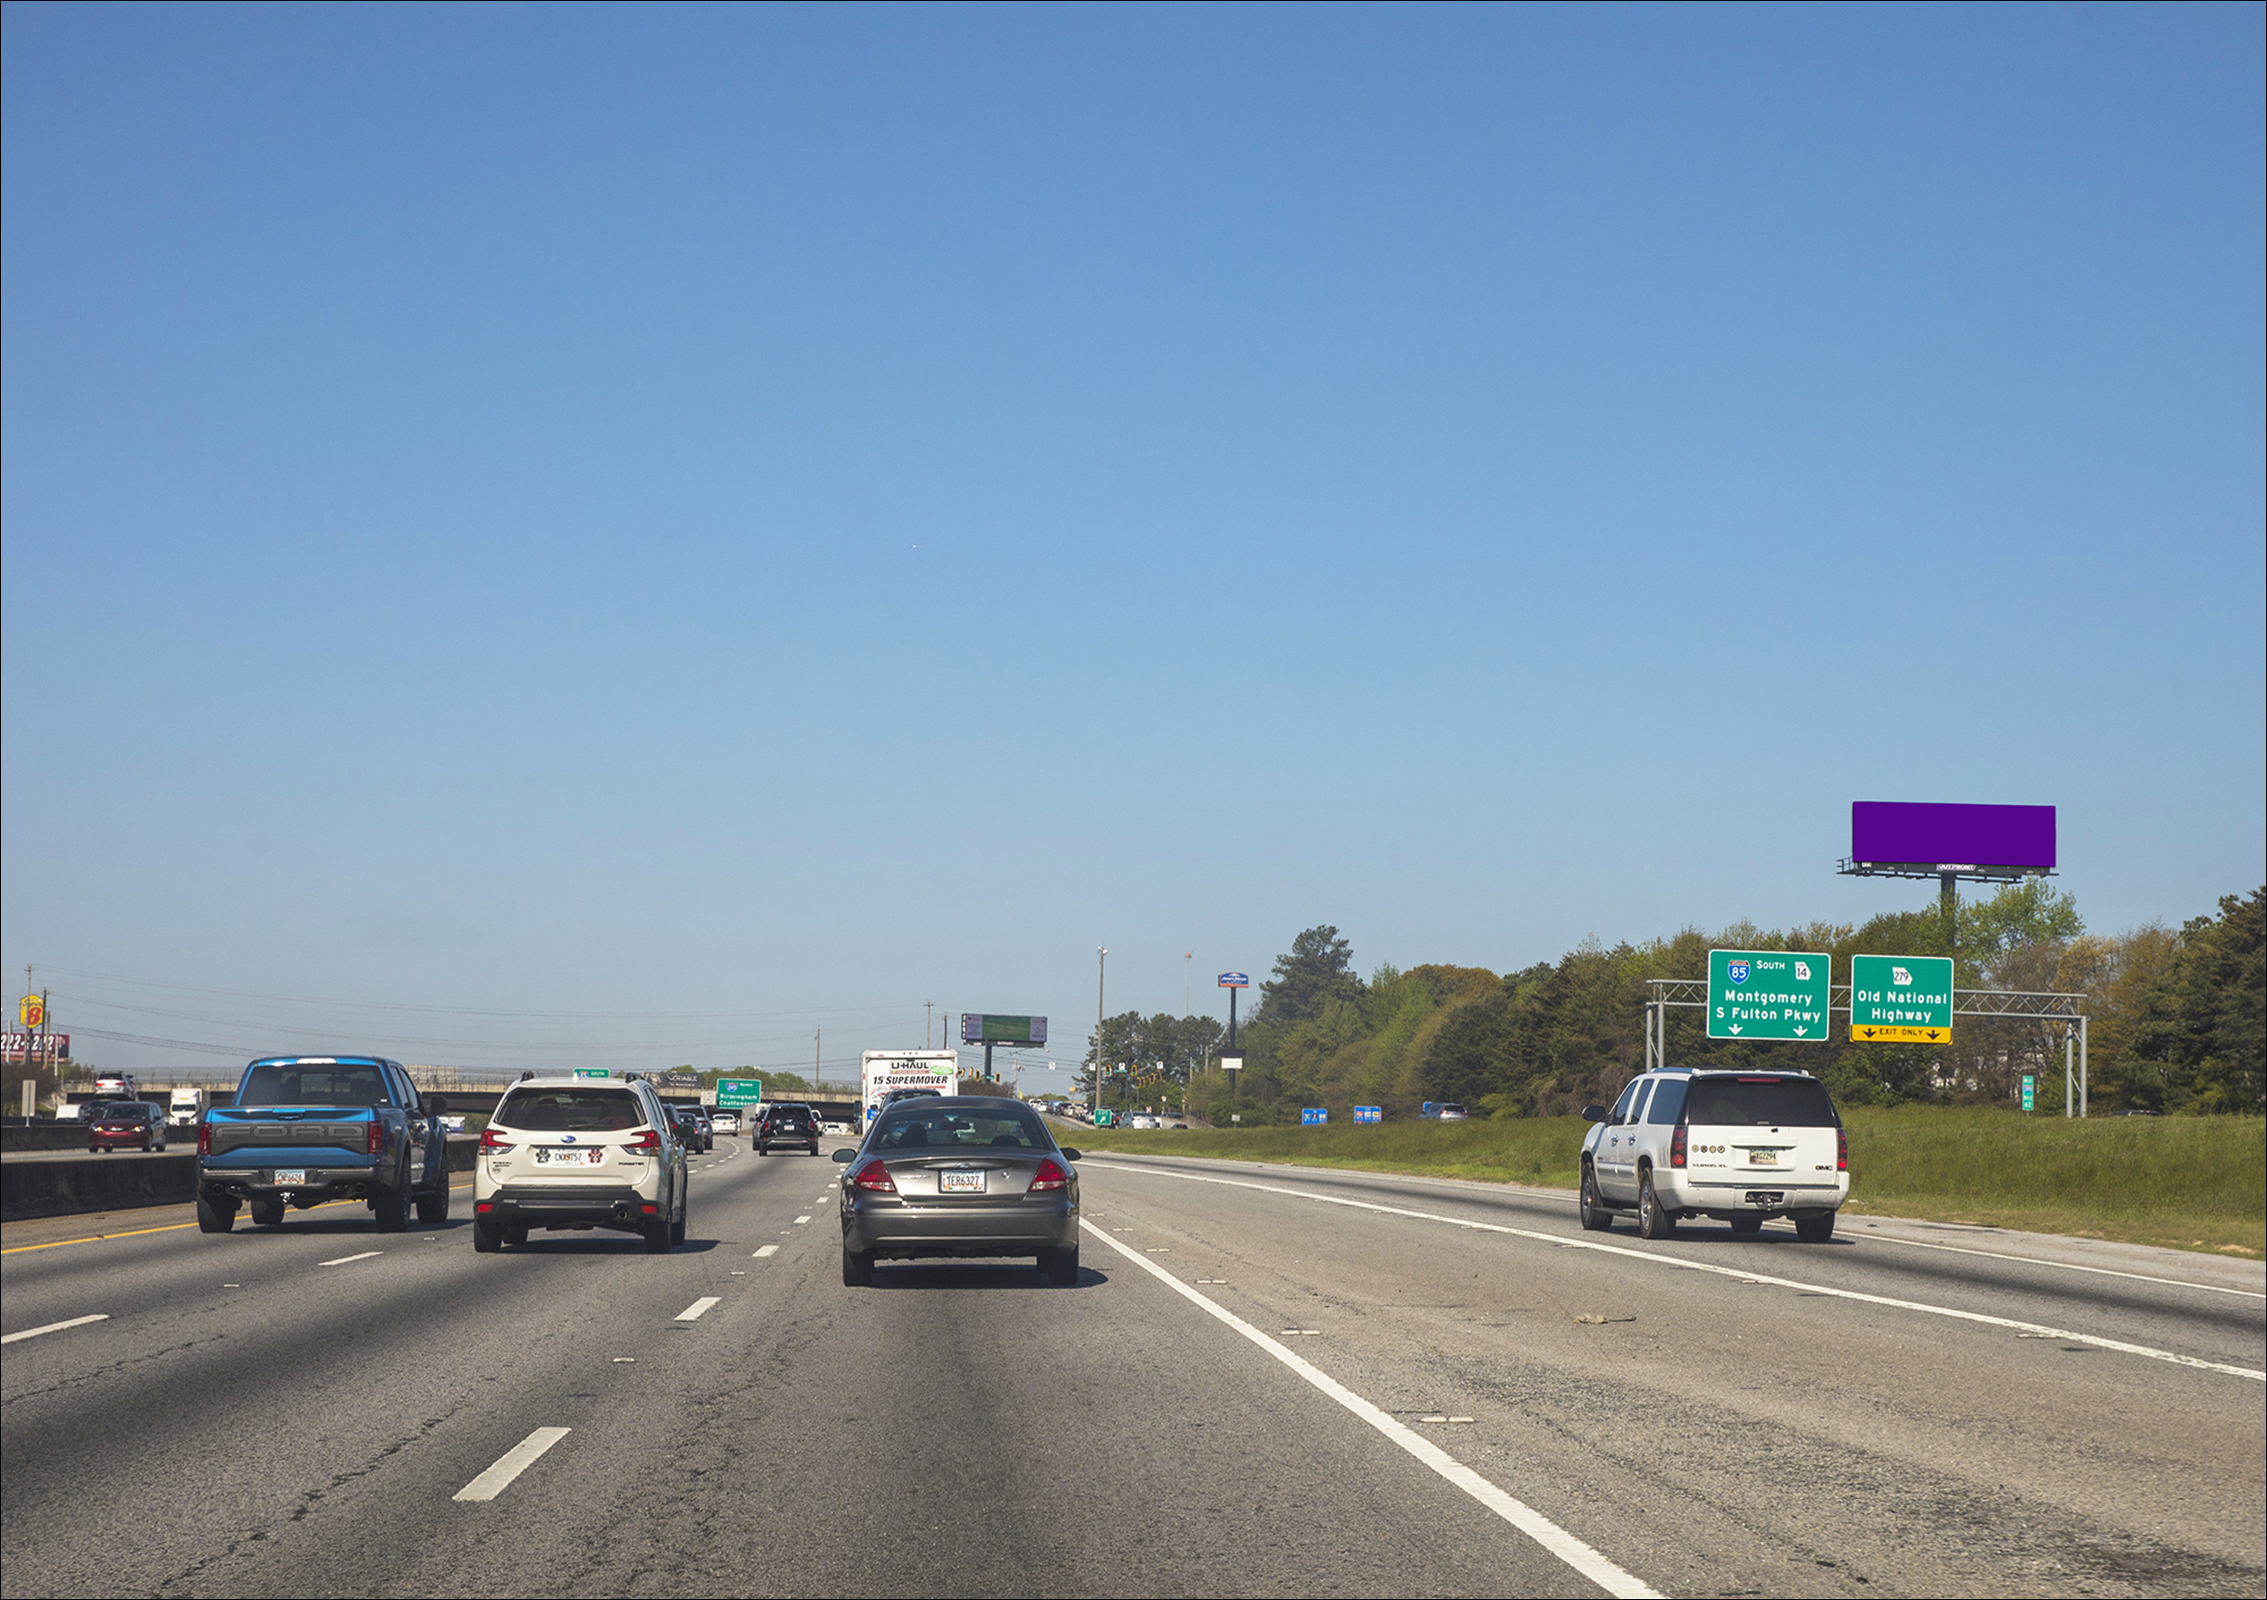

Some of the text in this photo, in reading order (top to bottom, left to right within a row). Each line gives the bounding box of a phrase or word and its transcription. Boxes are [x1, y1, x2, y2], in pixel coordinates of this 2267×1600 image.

[1756, 960, 1786, 970] SOUTH
[1732, 967, 1747, 979] 85
[1797, 968, 1807, 977] 14
[1894, 971, 1909, 982] 279
[1725, 989, 1813, 1007] Montgomery
[1857, 990, 1947, 1005] Old National
[28, 1006, 43, 1025] 8
[1716, 1006, 1821, 1024] S Fulton Pkwy
[1871, 1007, 1932, 1024] Highway
[891, 1062, 930, 1070] U-HAUL
[886, 1075, 949, 1085] SUPERMOVER
[719, 1093, 758, 1101] Birmingham
[215, 1125, 364, 1138] FORD
[946, 1175, 979, 1187] TER6327
